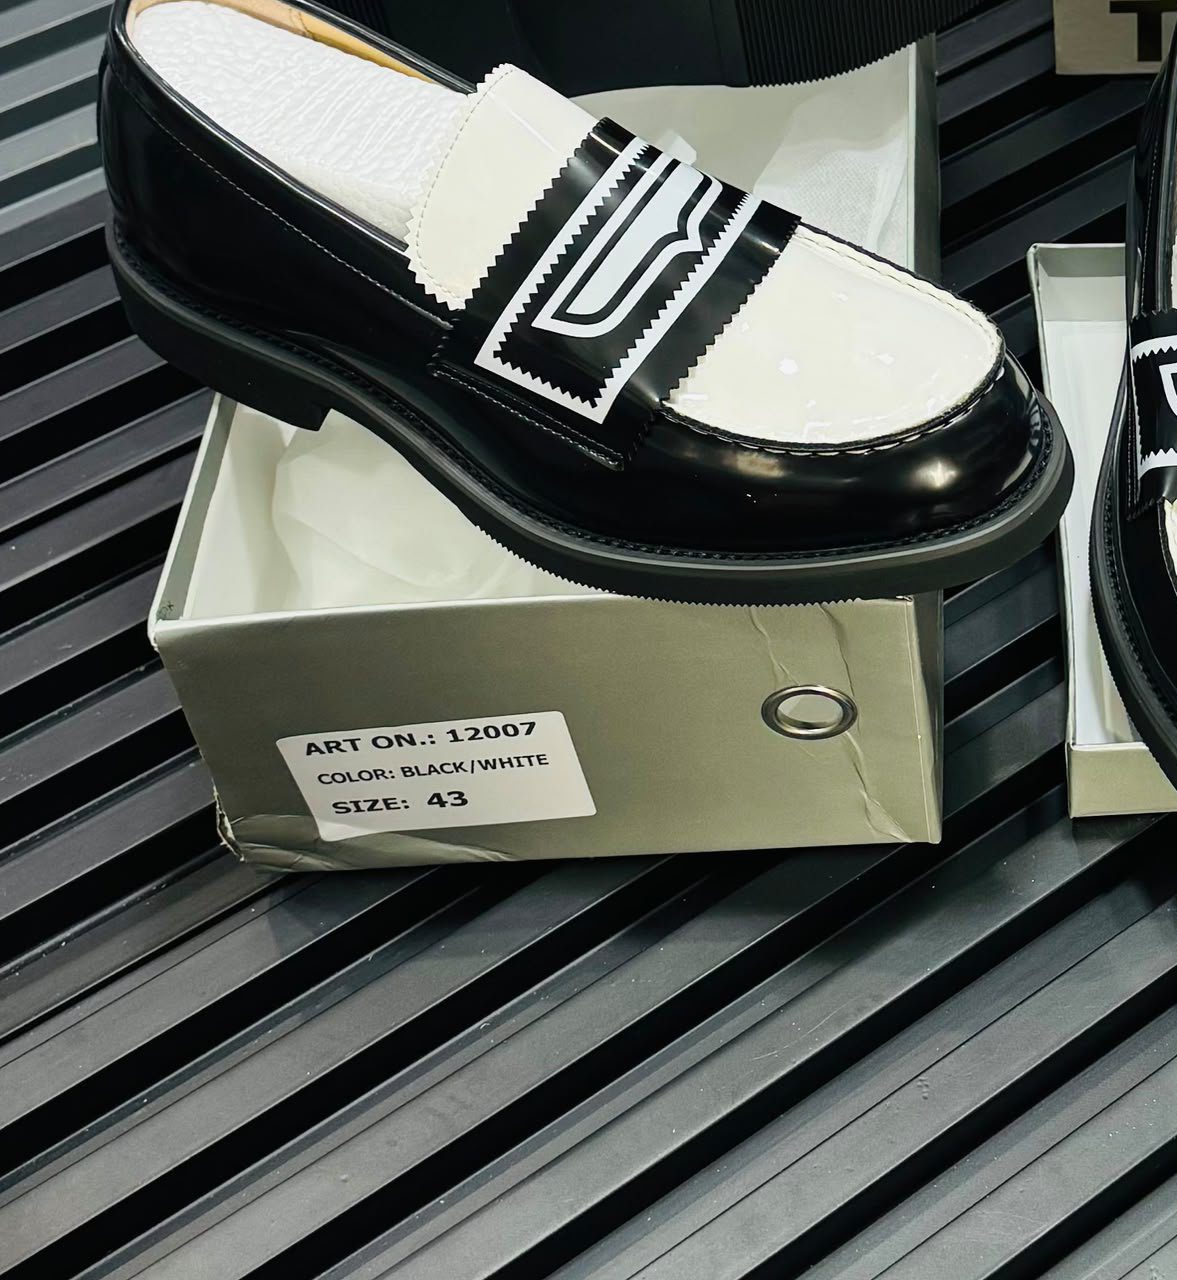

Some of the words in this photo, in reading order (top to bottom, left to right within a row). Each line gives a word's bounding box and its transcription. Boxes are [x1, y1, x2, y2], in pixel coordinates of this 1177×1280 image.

[305, 737, 362, 756] ART
[371, 731, 437, 751] ON.:
[447, 721, 538, 744] 12007
[317, 769, 396, 785] COLOR:
[401, 753, 550, 779] BLACK/WHITE
[332, 796, 411, 815] SIZE:
[426, 790, 469, 809] 43
